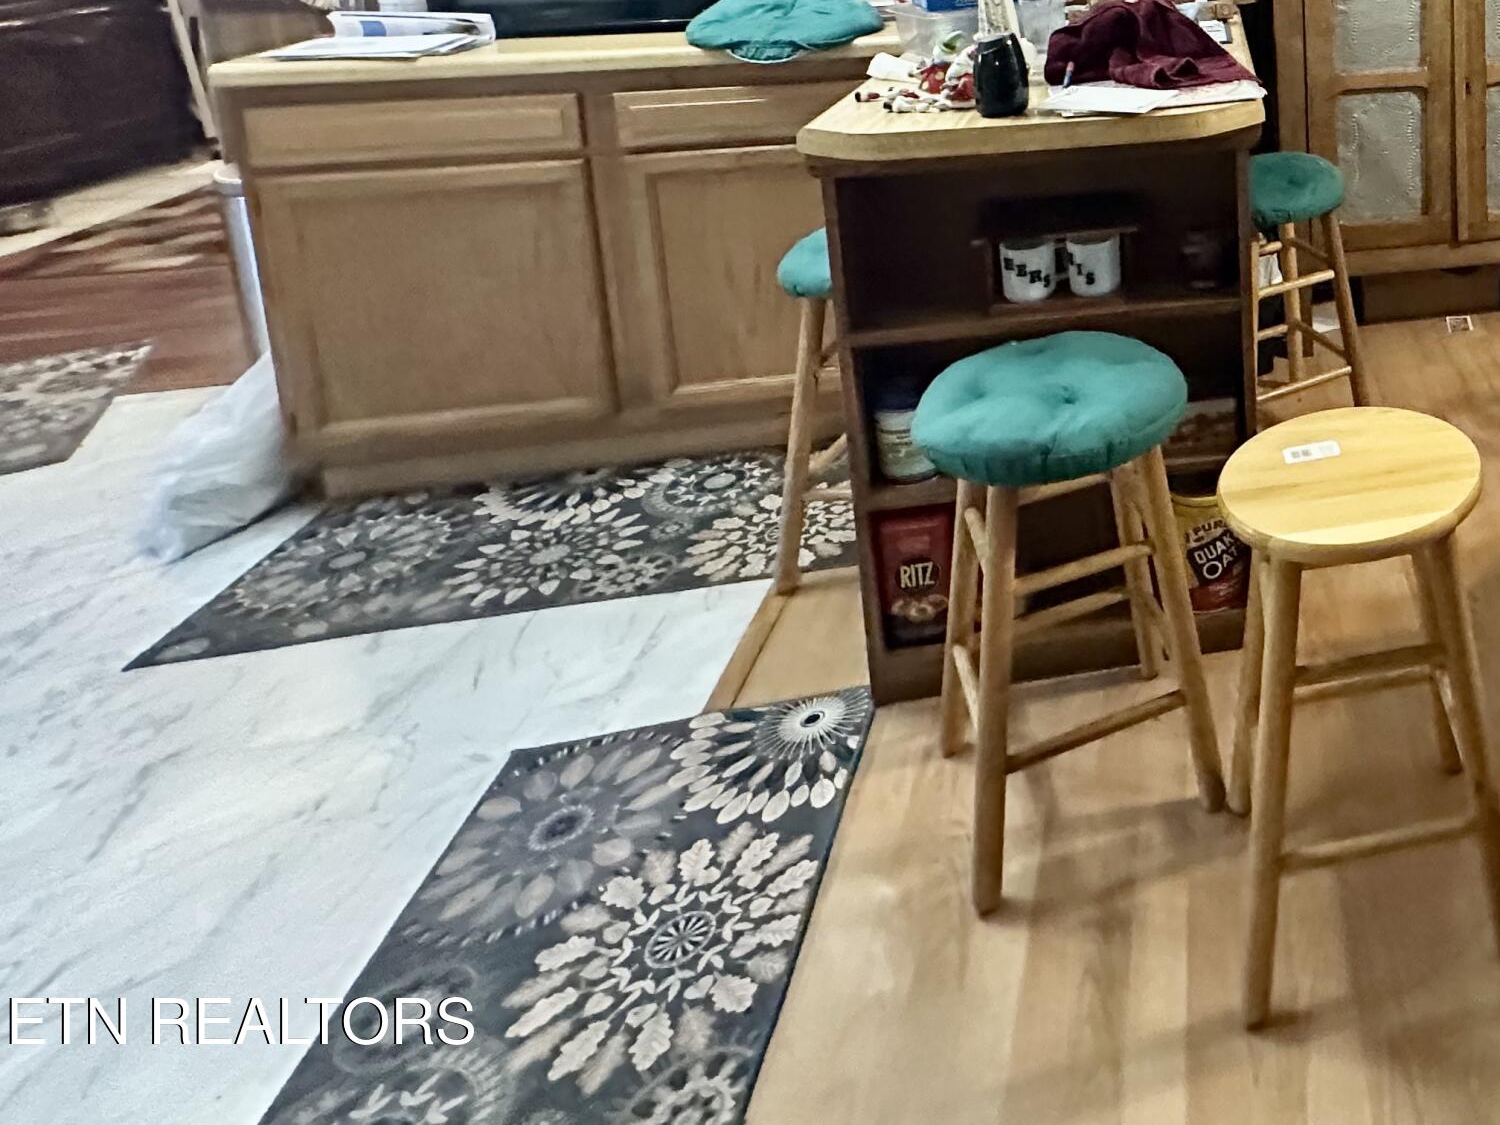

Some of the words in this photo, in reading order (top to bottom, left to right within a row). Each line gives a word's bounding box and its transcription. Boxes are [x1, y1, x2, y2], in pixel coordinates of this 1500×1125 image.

[1194, 533, 1234, 564] QUAK
[1203, 546, 1237, 579] OAT
[900, 561, 935, 589] RITZ
